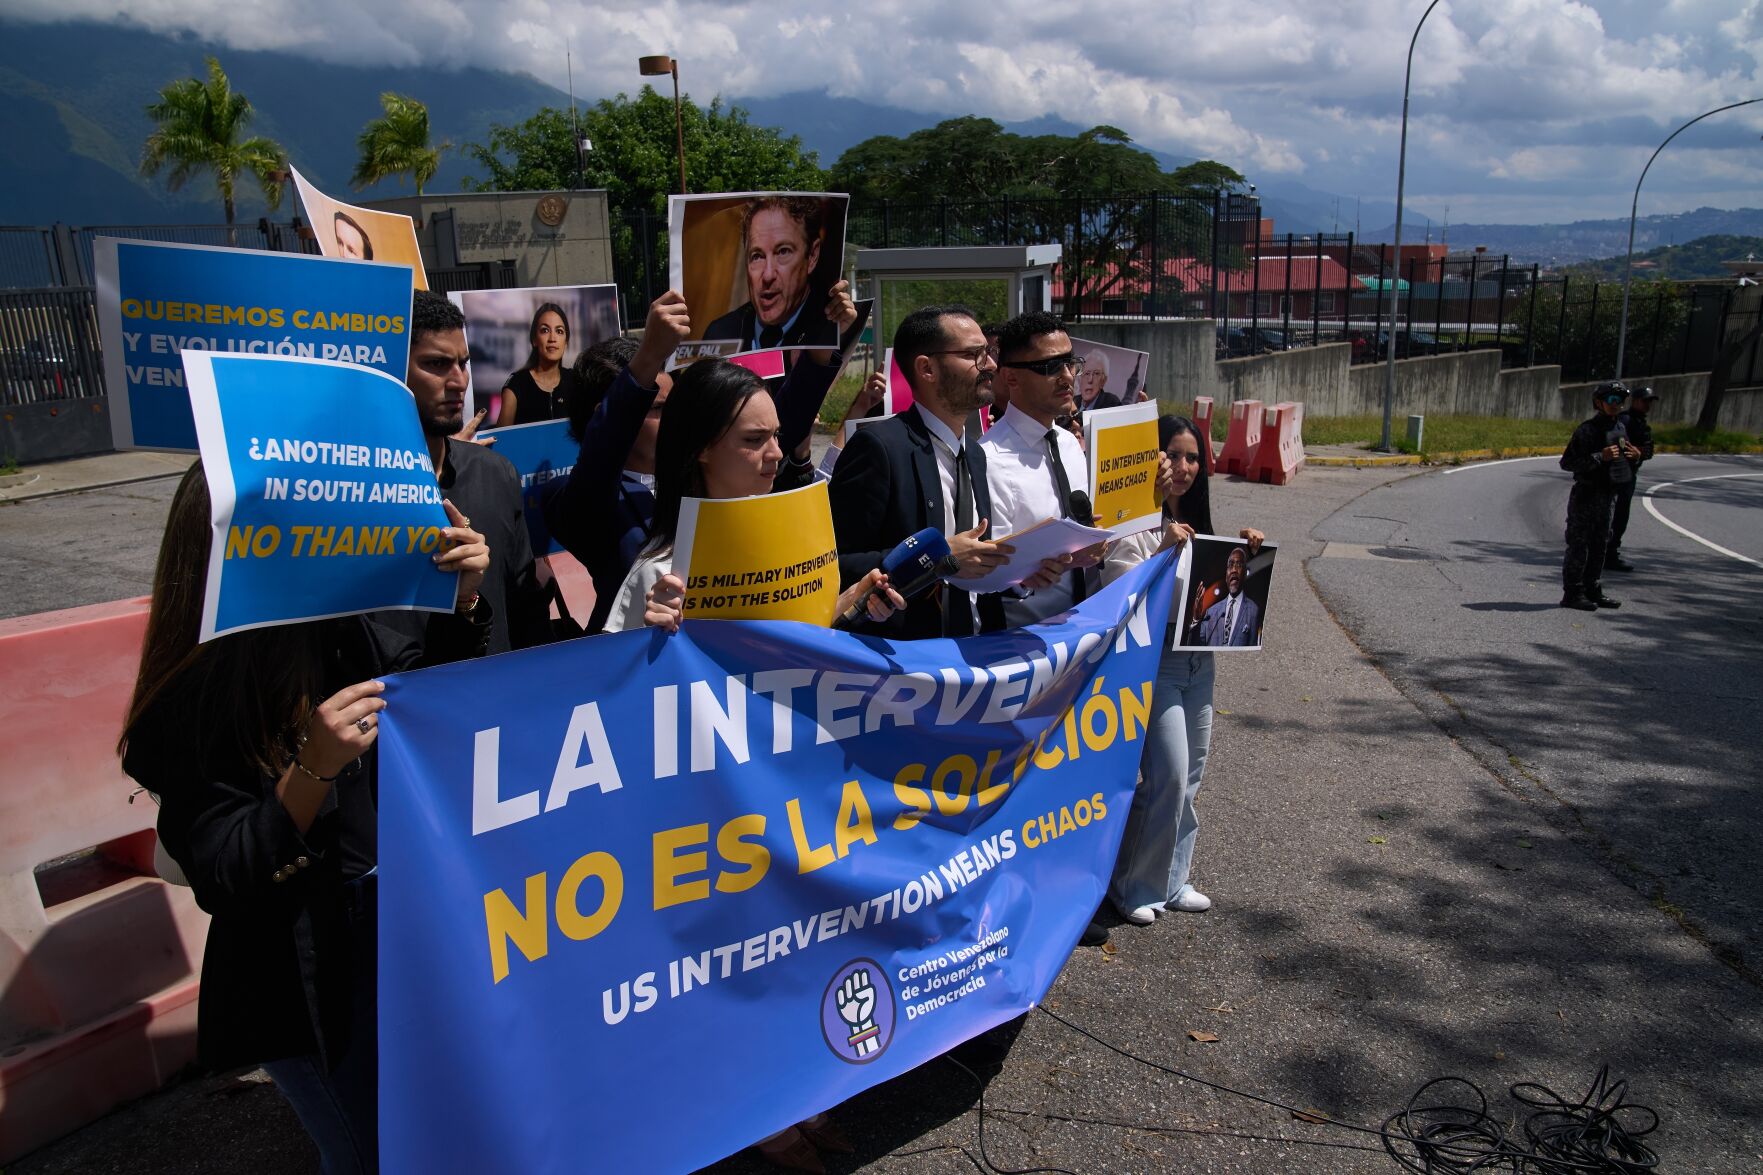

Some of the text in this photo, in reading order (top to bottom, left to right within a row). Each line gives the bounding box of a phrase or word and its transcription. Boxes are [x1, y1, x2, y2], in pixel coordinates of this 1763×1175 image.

[120, 298, 405, 335] QUEREMOS CAMBIOS
[123, 332, 143, 352] Y
[322, 343, 388, 364] PARA
[125, 365, 187, 388] VEN
[248, 437, 435, 474] ¿ANOTHER IRAQ-WA
[1100, 448, 1158, 474] US INTERVENTION
[264, 477, 289, 501] IN
[293, 478, 365, 502] SOUTH
[1099, 471, 1147, 495] MEANS CHAOS
[225, 525, 281, 560] NO
[290, 526, 402, 558] THANK
[685, 548, 838, 590] US MILITARY INTERVENTION
[681, 577, 823, 610] IS NOT THE SOLUTION
[472, 700, 624, 837] LA
[484, 676, 1153, 985] NO ES LA SOLCIÓN
[602, 792, 1107, 1026] US INTERVENTION MEANS CHAOS
[898, 926, 1009, 982] Centro Venezolano
[901, 946, 1008, 1001] de Jóvenes por la
[905, 975, 986, 1021] Democracia
